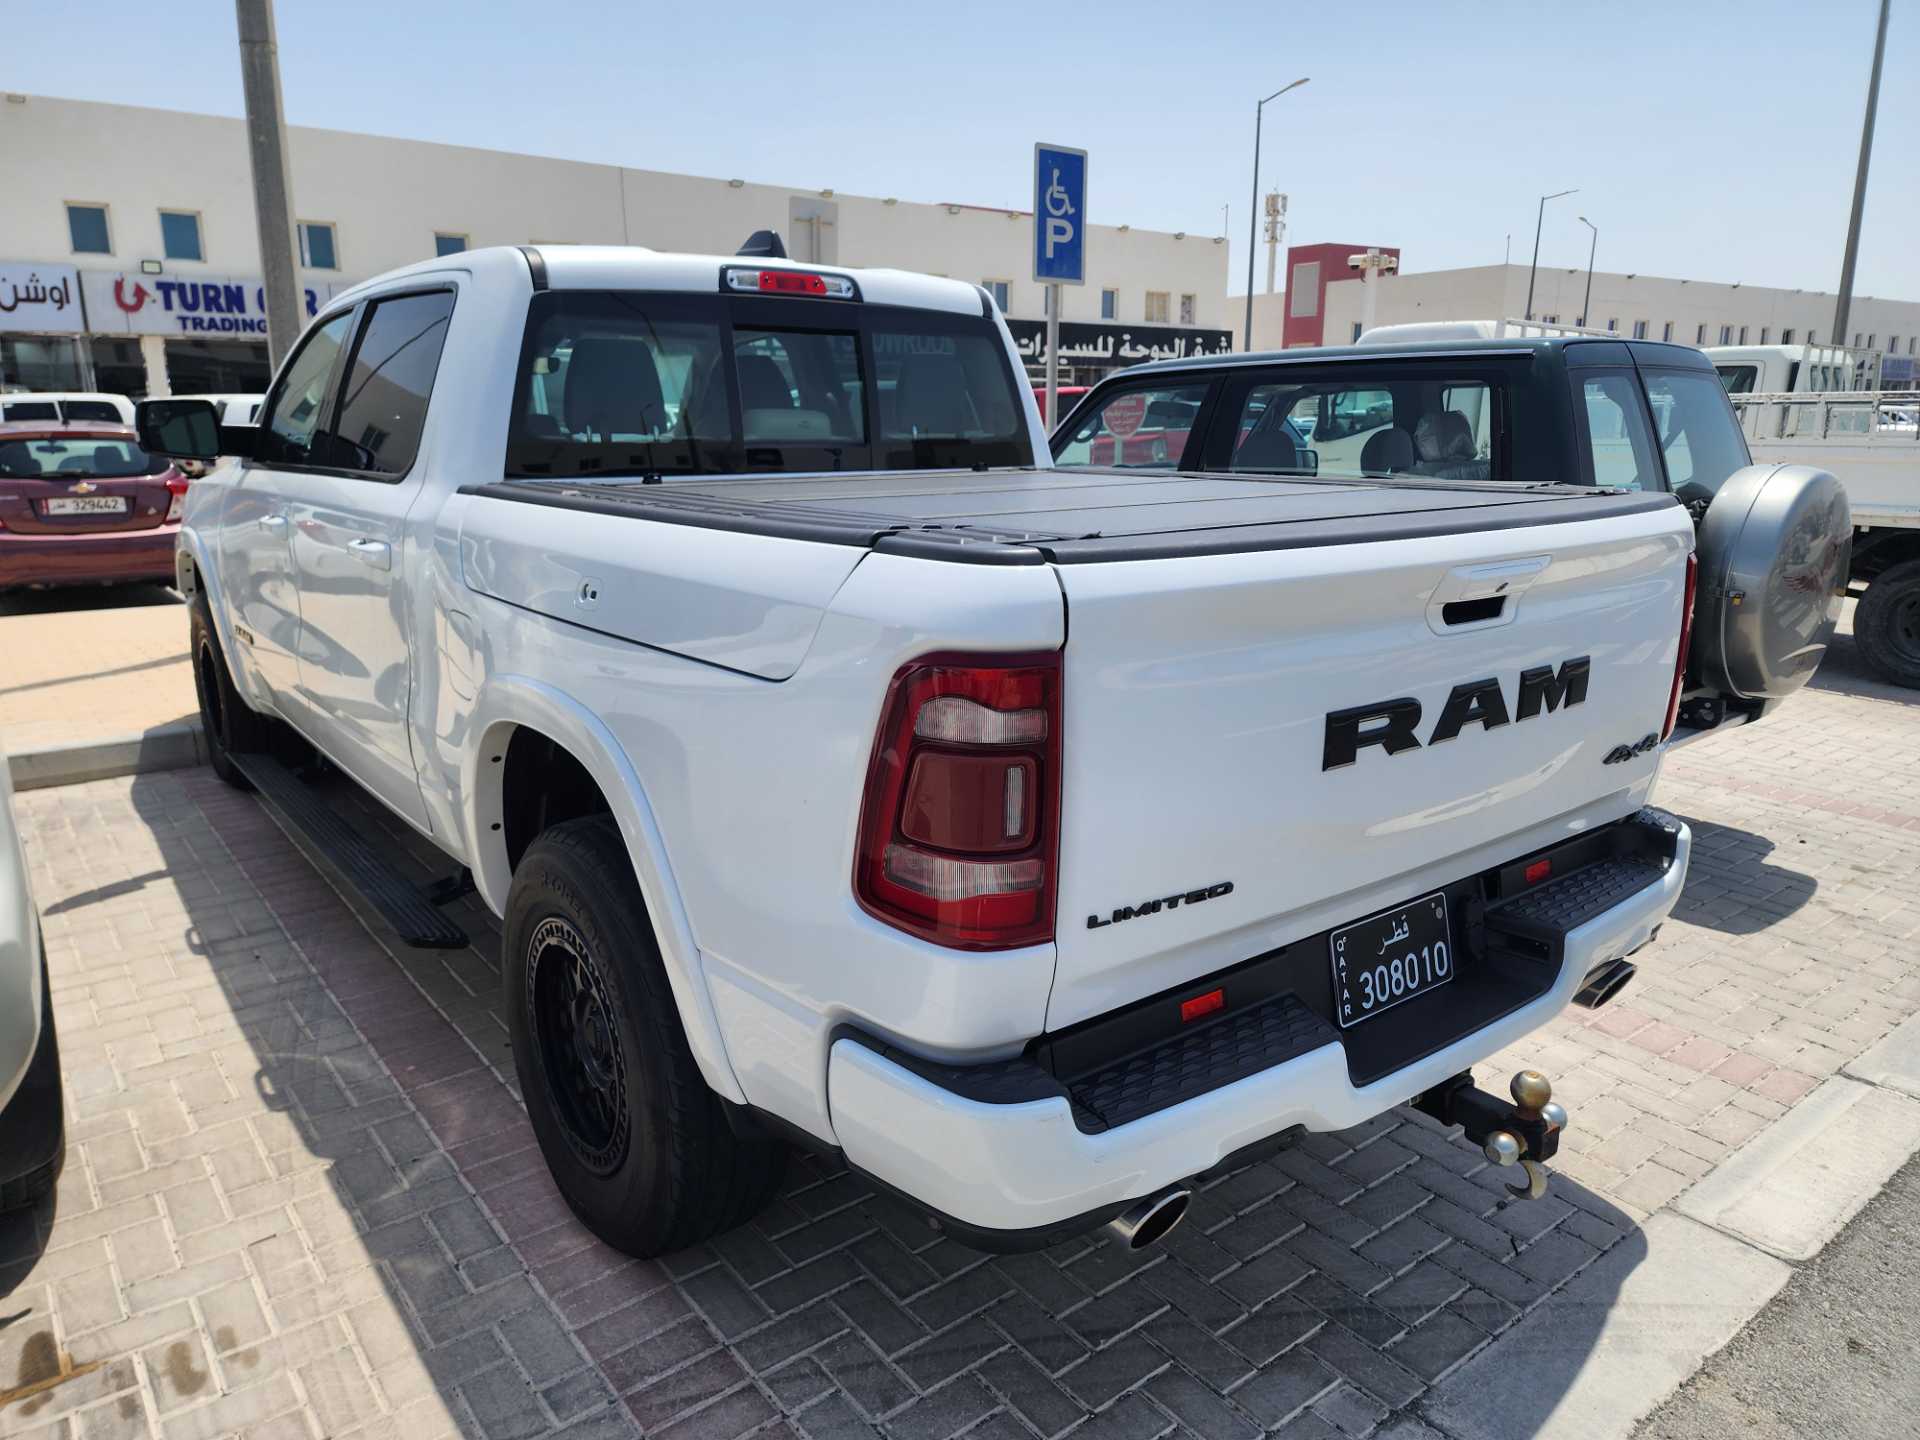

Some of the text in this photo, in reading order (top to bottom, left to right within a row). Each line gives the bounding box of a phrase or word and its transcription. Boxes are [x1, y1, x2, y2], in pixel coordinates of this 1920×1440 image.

[1046, 217, 1074, 259] P
[155, 281, 246, 314] TURN
[177, 316, 267, 334] TRADING
[1016, 332, 1115, 364] للسيرات
[1119, 333, 1186, 362] الدوحة
[1322, 655, 1591, 772] RAM
[1087, 877, 1235, 929] LIMITED
[1377, 914, 1410, 955] قطر
[1336, 937, 1352, 1016] QATAR
[1360, 941, 1449, 1009] 308010
